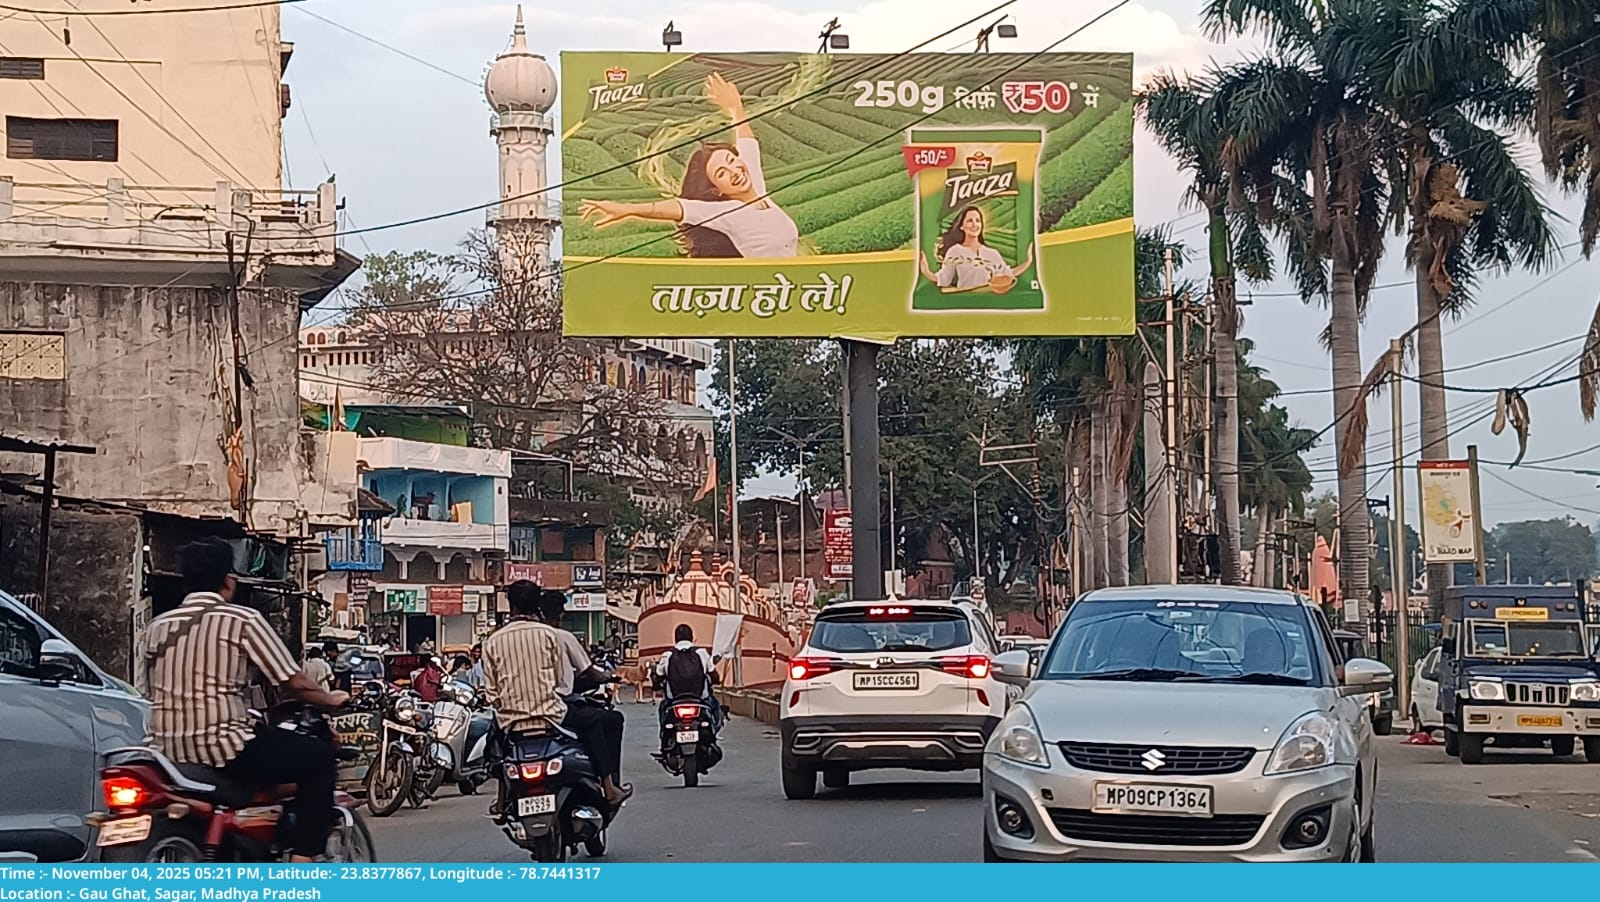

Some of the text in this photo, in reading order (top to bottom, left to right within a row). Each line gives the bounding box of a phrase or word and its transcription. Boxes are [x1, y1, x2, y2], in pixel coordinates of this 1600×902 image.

[589, 82, 645, 110] Taaza
[853, 80, 944, 113] 250g
[1082, 85, 1100, 109] में
[945, 172, 1013, 207] Taaza
[651, 272, 853, 317] ताज़ा हो ले!
[859, 676, 916, 686] MP15CC4561
[1106, 787, 1207, 808] MP09CP1364
